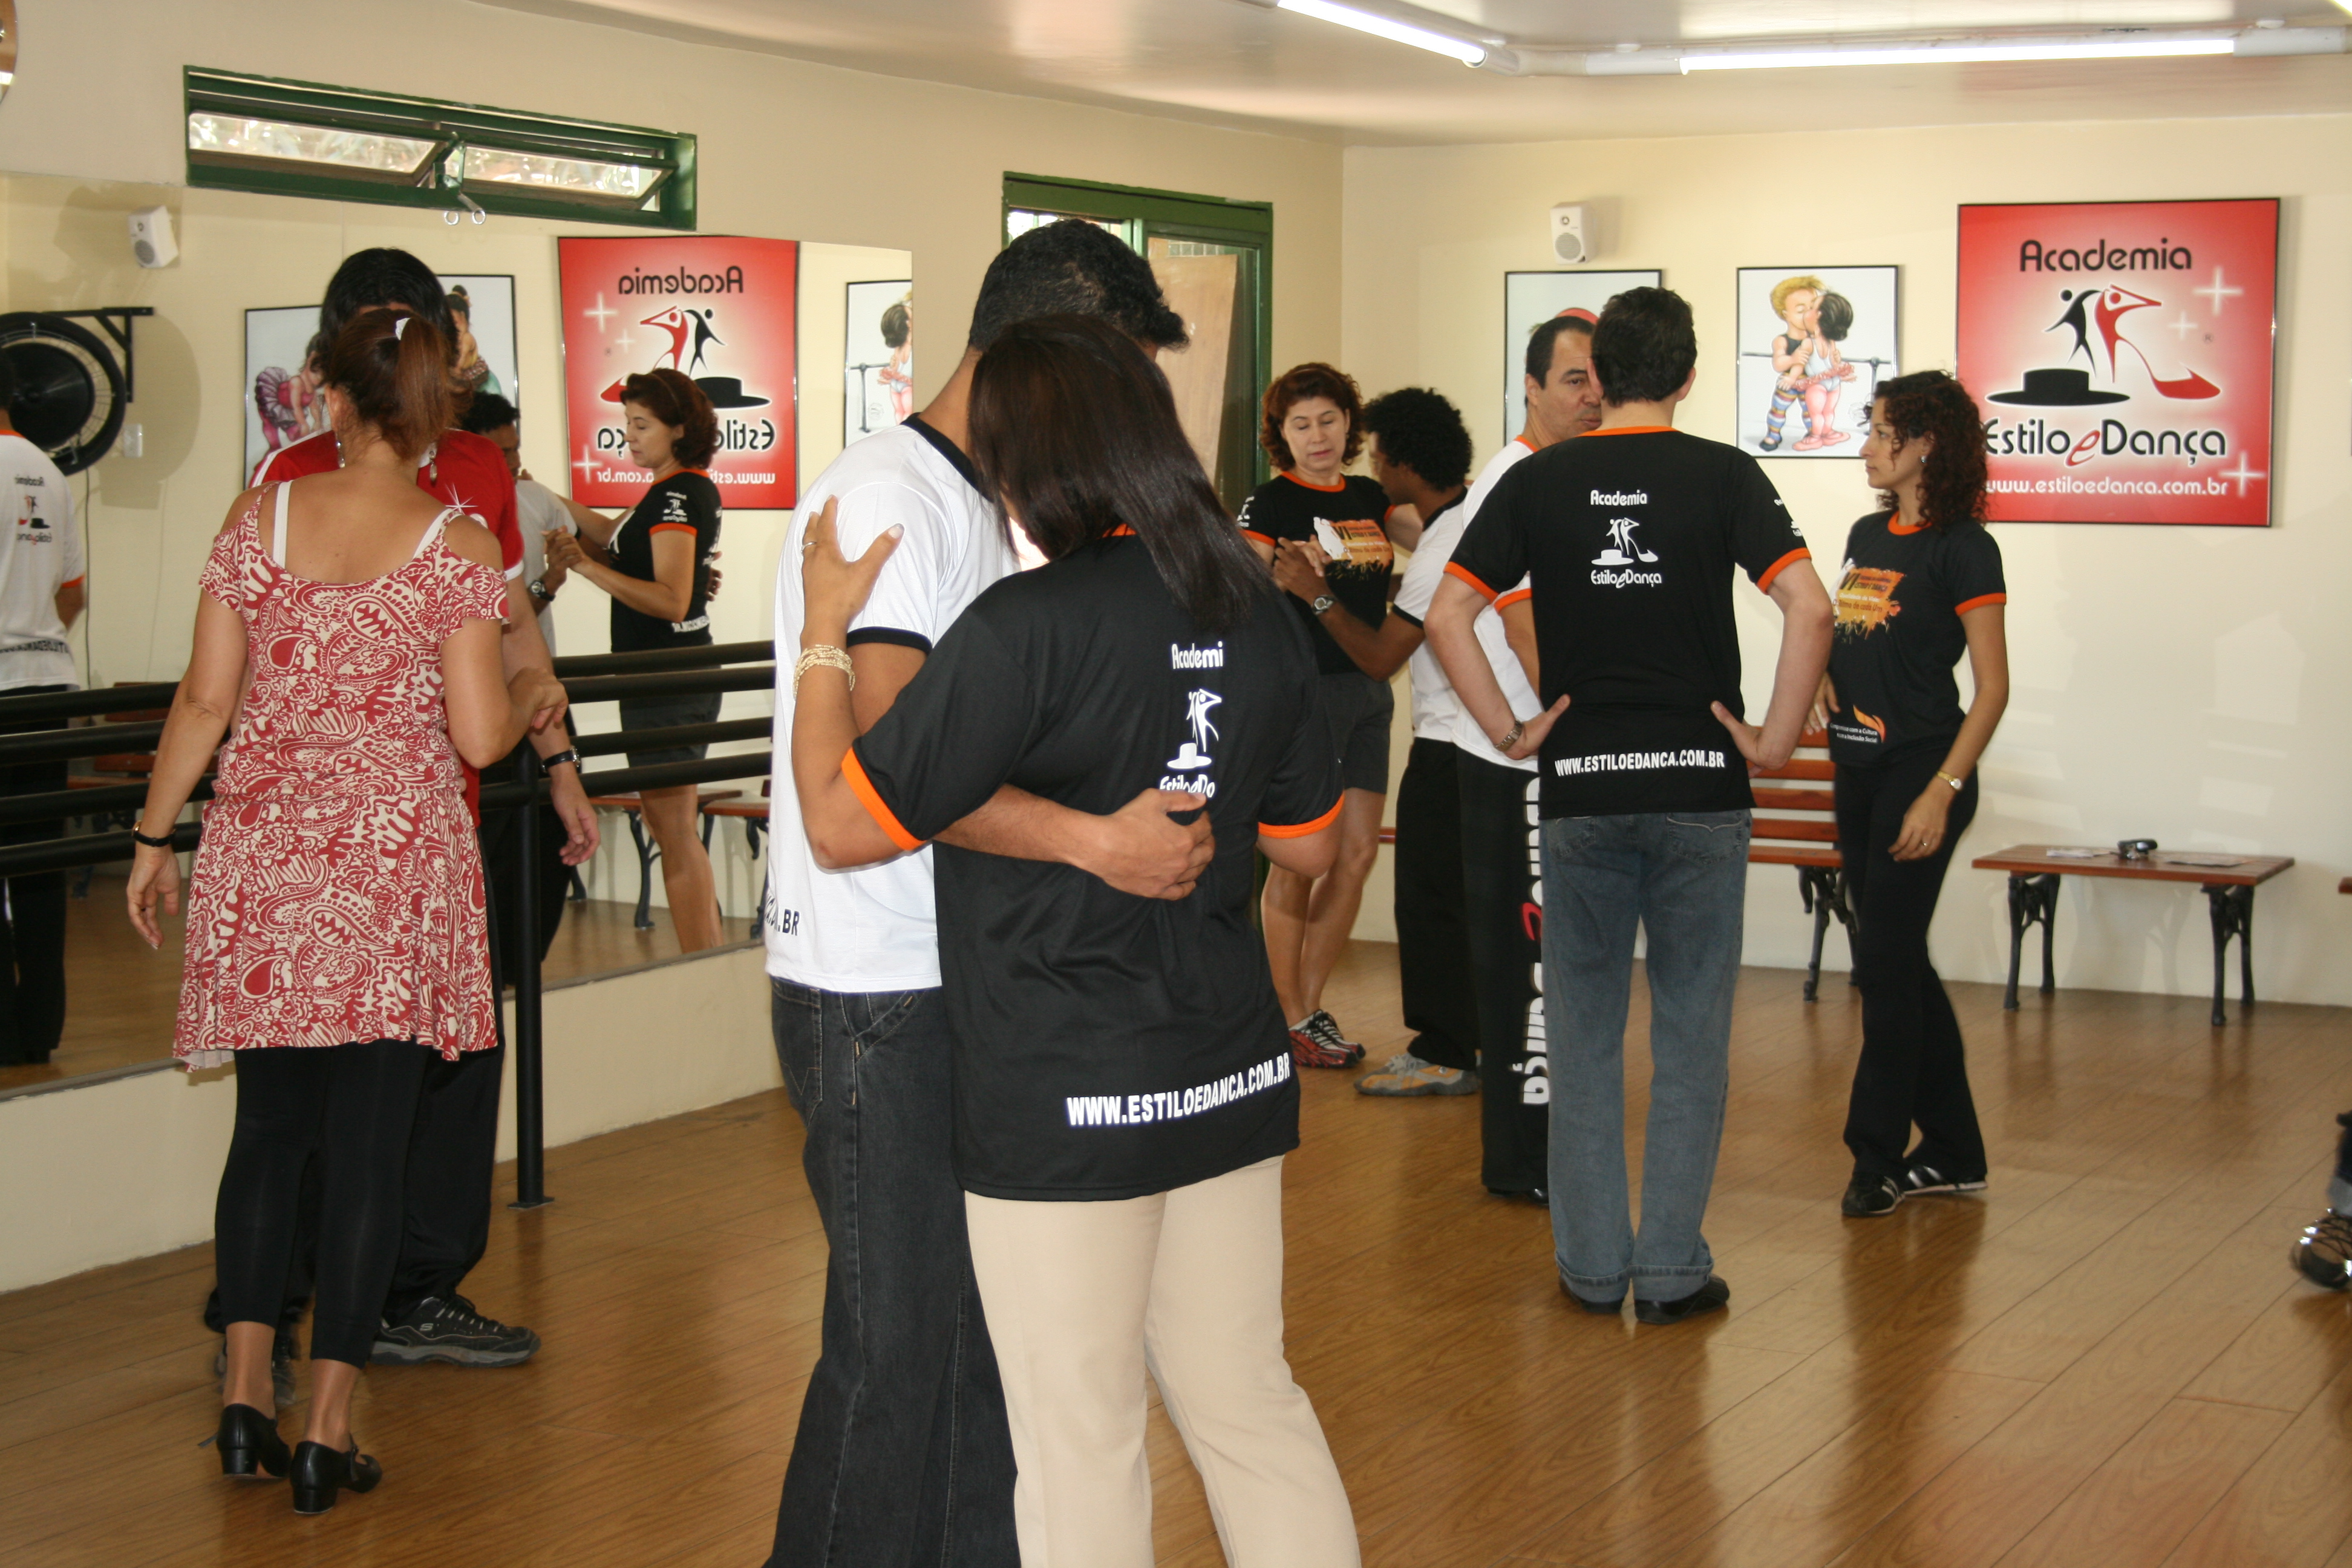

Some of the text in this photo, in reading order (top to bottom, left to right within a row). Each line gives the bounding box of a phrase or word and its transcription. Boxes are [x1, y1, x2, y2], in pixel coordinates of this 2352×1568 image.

[2019, 237, 2192, 272] Academia
[1590, 489, 1648, 506] Academia
[1554, 749, 1725, 777] WWW.ESTILOEDANCA.COM.BR
[1067, 1051, 1290, 1126] WWW.ESTILOEDANCA.COM.BR
